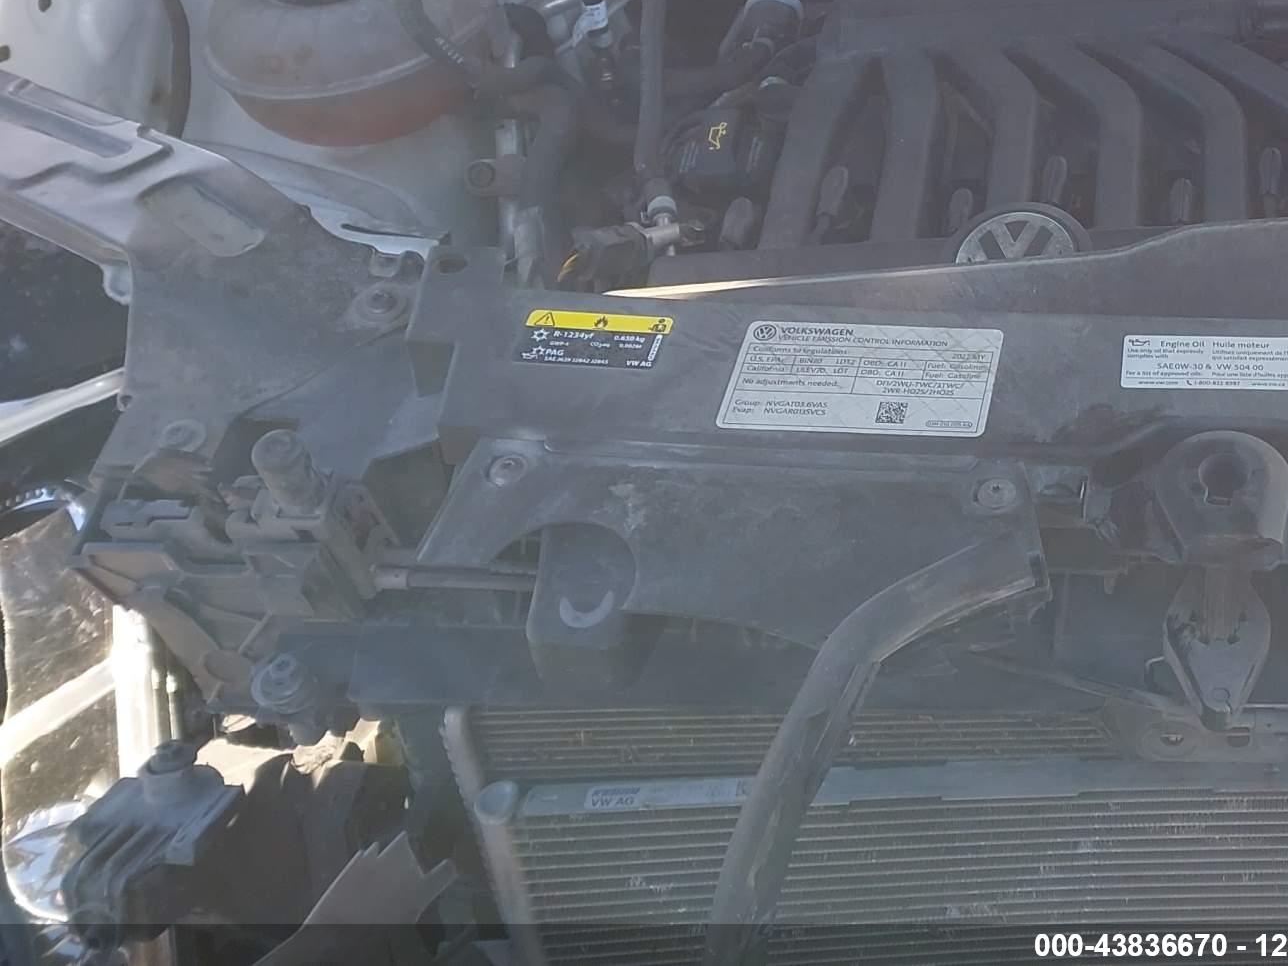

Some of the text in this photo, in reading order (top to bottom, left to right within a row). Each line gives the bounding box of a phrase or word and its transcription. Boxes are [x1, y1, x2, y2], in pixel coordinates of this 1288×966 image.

[553, 330, 595, 340] R-1234yf
[780, 326, 854, 336] VOLKSWAGEN
[852, 337, 890, 345] CONTROL
[891, 338, 948, 347] INFORMATION
[1160, 340, 1191, 349] Engine
[545, 348, 564, 356] PAG
[1216, 363, 1232, 371] VW
[755, 378, 805, 386] adjustments
[591, 797, 635, 807] VW AG
